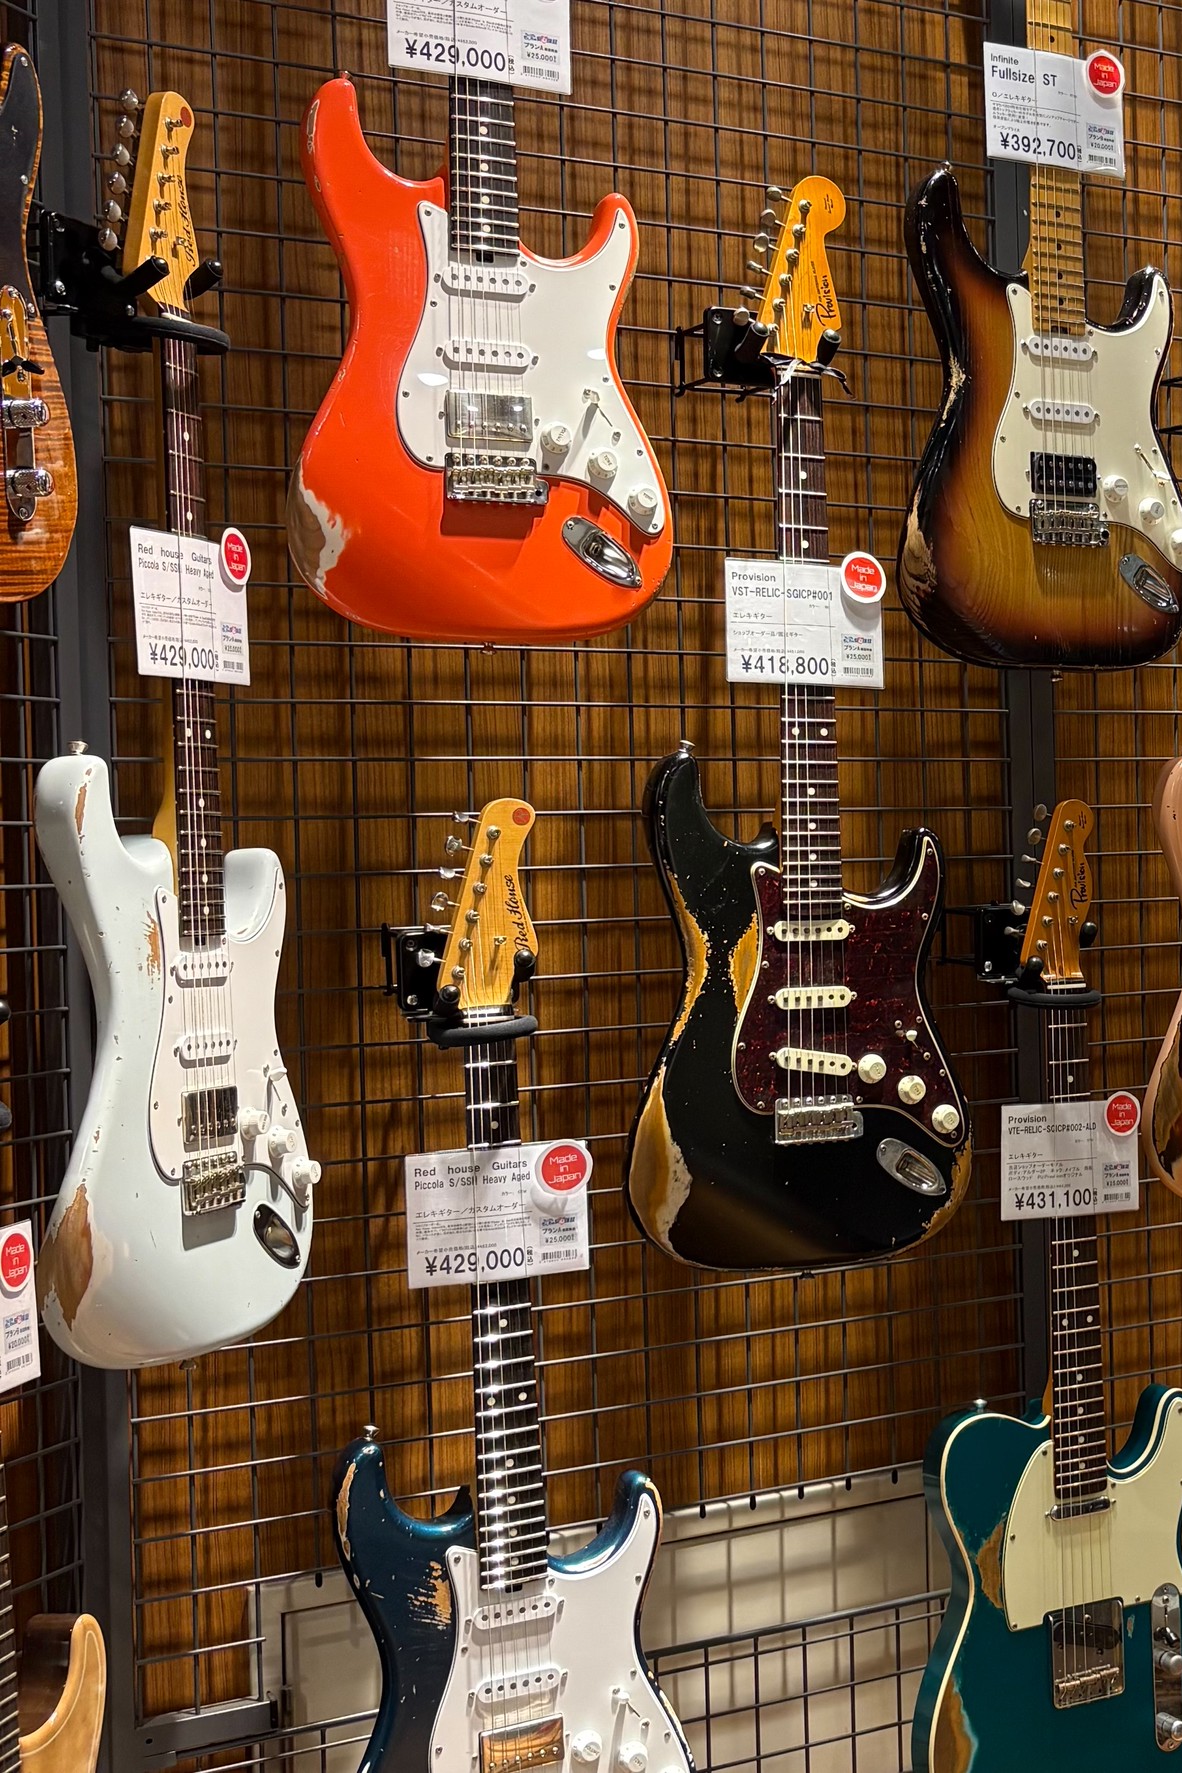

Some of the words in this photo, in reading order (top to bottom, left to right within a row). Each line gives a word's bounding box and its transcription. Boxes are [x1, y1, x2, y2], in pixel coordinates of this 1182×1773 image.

[405, 38, 506, 72] ¥429,000
[990, 53, 1019, 66] Infinite
[1093, 63, 1115, 73] Made
[991, 65, 1035, 84] Fullsize
[1042, 73, 1058, 87] ST
[1093, 79, 1118, 88] Japan
[1000, 131, 1076, 160] ¥392,700
[815, 275, 836, 327] Provision
[138, 543, 153, 555] Red
[160, 547, 184, 560] house
[191, 552, 212, 565] Guitars
[227, 542, 243, 553] Made
[233, 553, 239, 562] in
[138, 557, 160, 570] Piccola
[185, 564, 201, 577] Heavy
[203, 568, 214, 580] Aged
[229, 563, 246, 572] Japan
[851, 564, 875, 575] Made
[731, 571, 776, 583] Provision
[859, 574, 868, 582] in
[731, 586, 833, 601] VST-RELIC-SGICP#001
[850, 582, 878, 593] Japan
[733, 612, 773, 620] エレキギター
[149, 642, 215, 670] ¥429,000
[741, 654, 830, 676] ¥418,800
[1070, 862, 1088, 910] Provision
[504, 874, 524, 920] House
[514, 921, 530, 951] Red
[1112, 1103, 1132, 1111] Made
[1008, 1114, 1047, 1125] Provision
[1118, 1110, 1126, 1118] in
[1111, 1118, 1134, 1128] Japan
[549, 1152, 578, 1165] Made
[414, 1168, 436, 1177] Red
[447, 1164, 481, 1175] house
[492, 1159, 528, 1171] Guitars
[559, 1164, 569, 1173] in
[414, 1177, 444, 1191] Piccola
[482, 1173, 507, 1185] Heavy
[511, 1170, 531, 1183] Aged
[548, 1172, 582, 1185] Japan
[1015, 1188, 1092, 1211] ¥431,100
[5, 1243, 25, 1257] Made
[12, 1256, 20, 1266] in
[425, 1247, 525, 1277] ¥429,000
[5, 1265, 28, 1279] Japan
